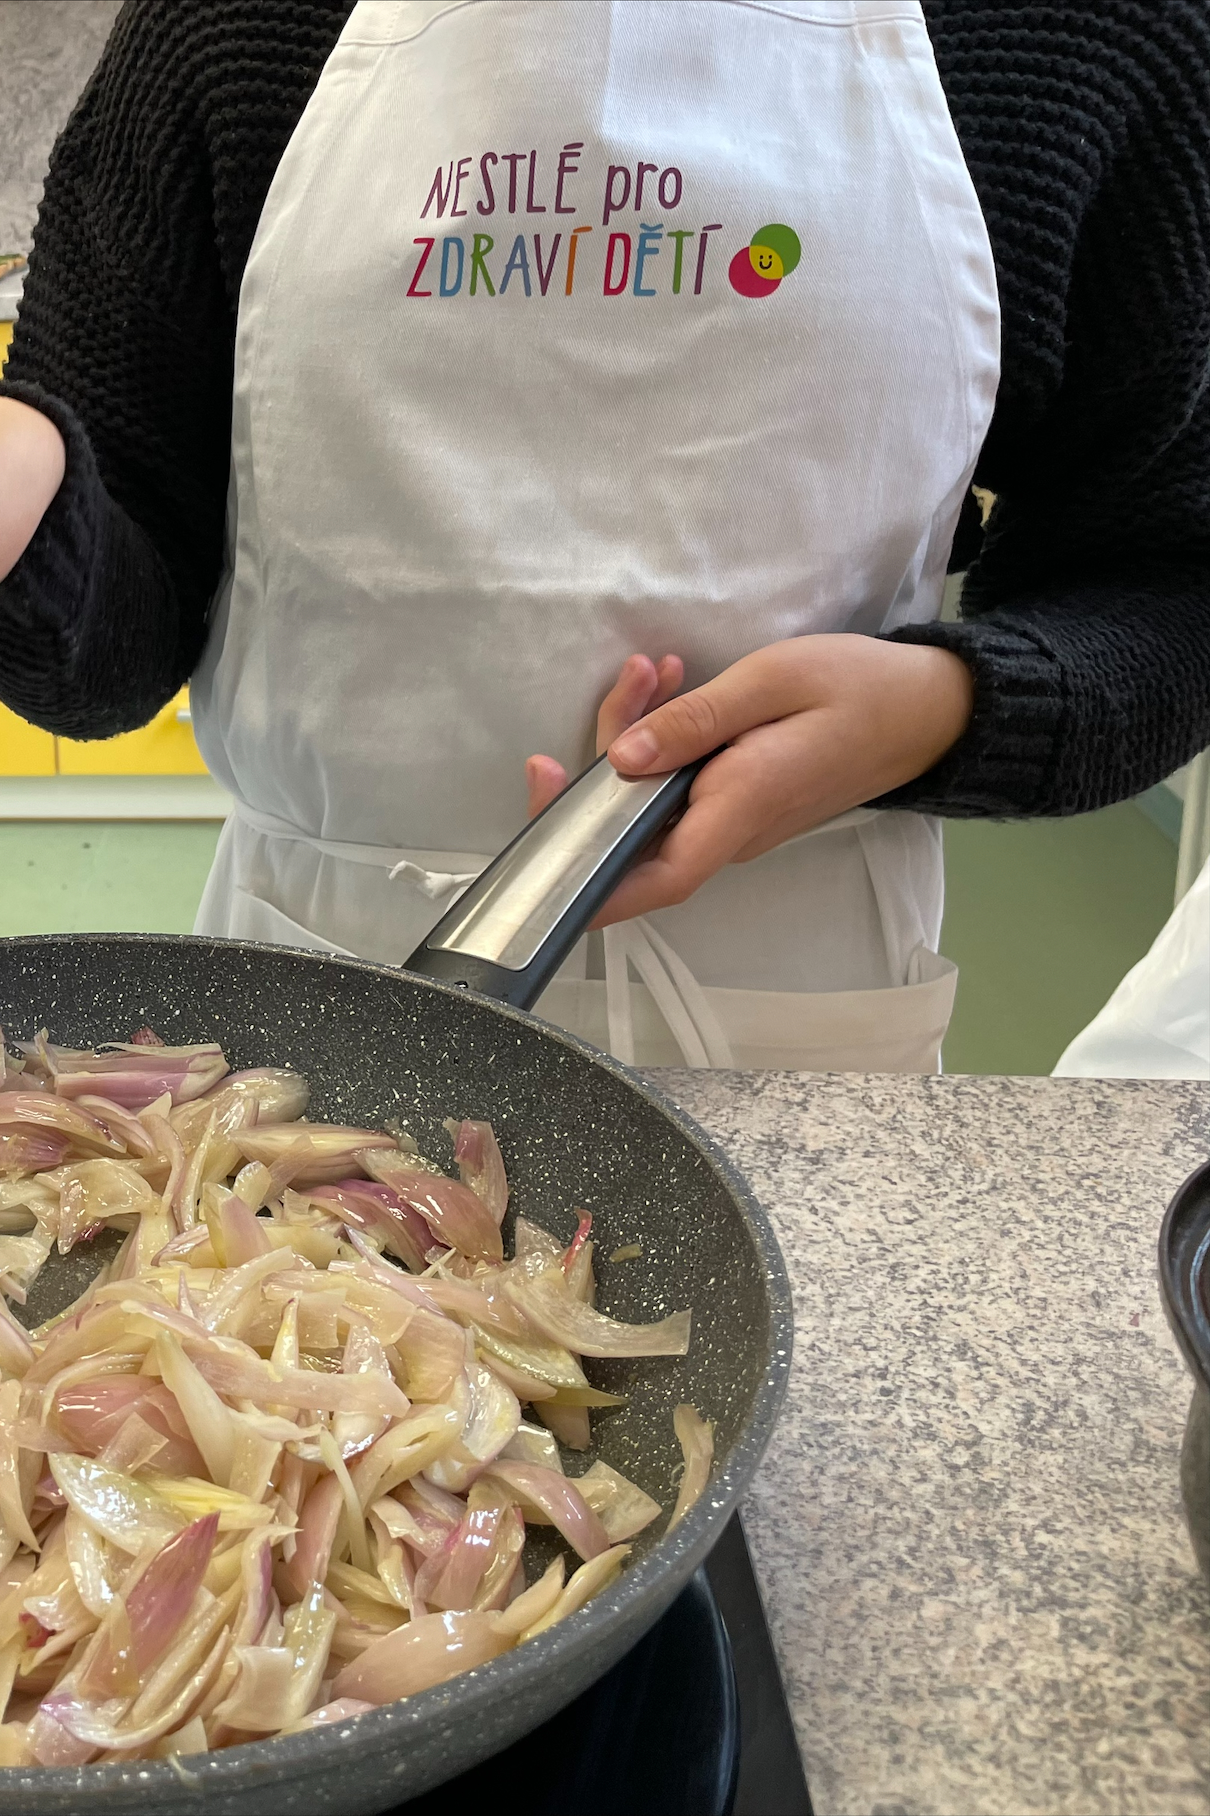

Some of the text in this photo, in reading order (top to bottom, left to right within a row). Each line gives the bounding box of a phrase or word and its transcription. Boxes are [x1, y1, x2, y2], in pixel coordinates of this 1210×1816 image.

[419, 141, 683, 226] NESTLÉ pro
[406, 222, 723, 298] ZDRAVÍ DĚTÍ
